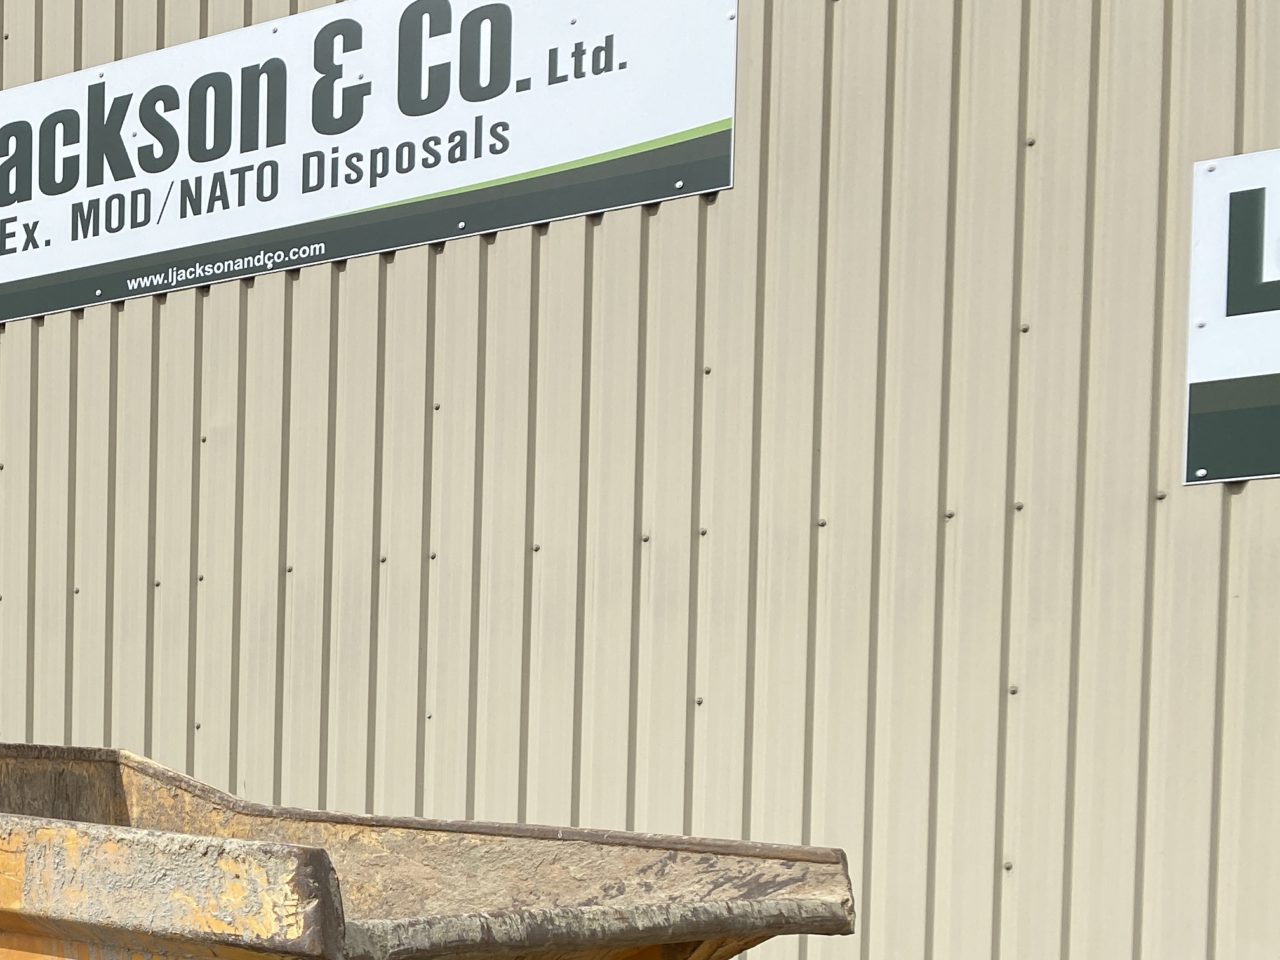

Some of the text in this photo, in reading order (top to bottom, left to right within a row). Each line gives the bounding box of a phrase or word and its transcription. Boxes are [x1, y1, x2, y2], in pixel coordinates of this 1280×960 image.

[311, 18, 373, 136] &
[397, 0, 532, 118] Co.
[548, 33, 628, 86] Ltd.
[0, 114, 511, 257] Ex. MOD/NATO Disposals
